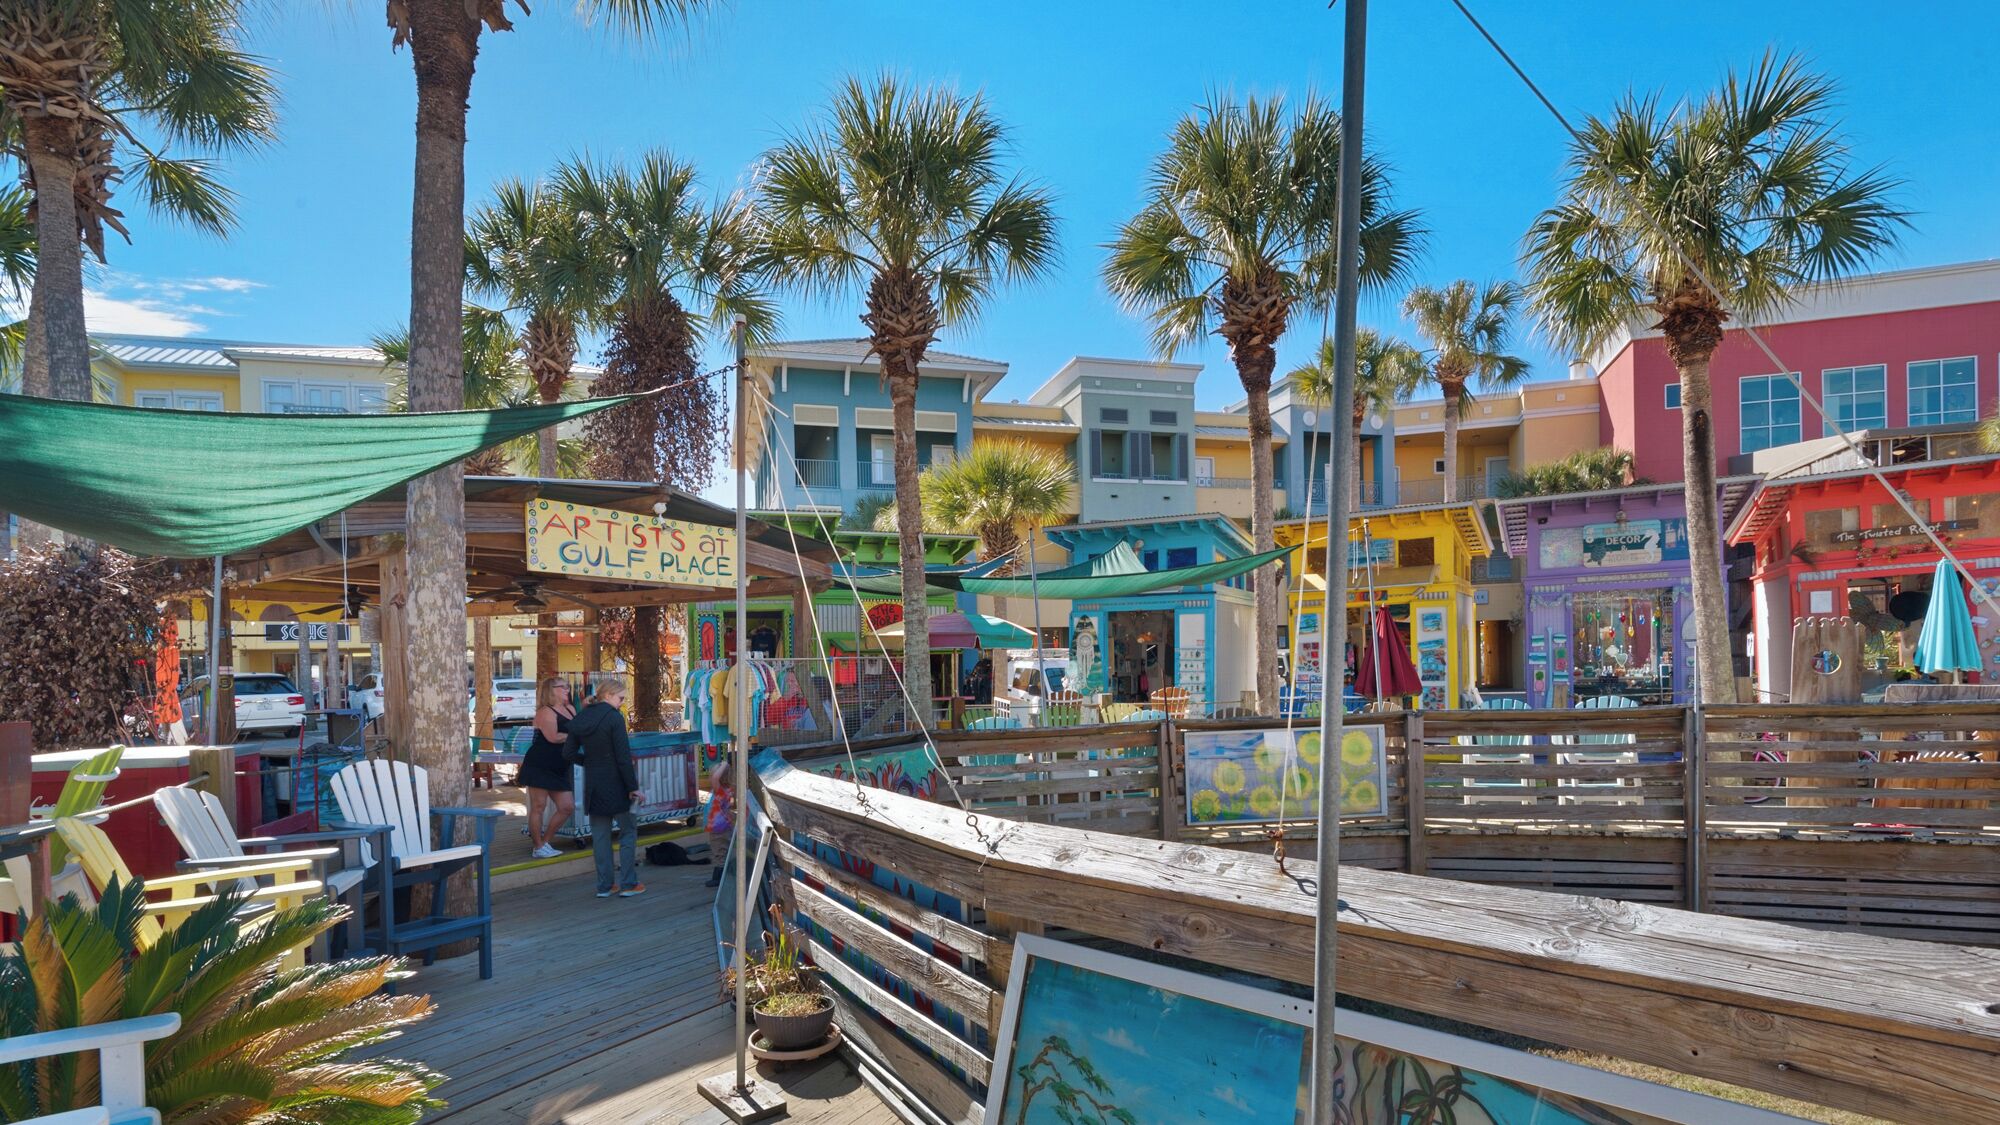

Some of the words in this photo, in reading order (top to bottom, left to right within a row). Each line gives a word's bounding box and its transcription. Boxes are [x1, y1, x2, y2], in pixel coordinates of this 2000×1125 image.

[542, 513, 686, 552] ARTISTS
[1837, 532, 1855, 542] The
[1605, 535, 1641, 546] DECOR
[559, 541, 647, 568] GULF
[660, 552, 733, 576] PLACE
[872, 604, 895, 615] THE
